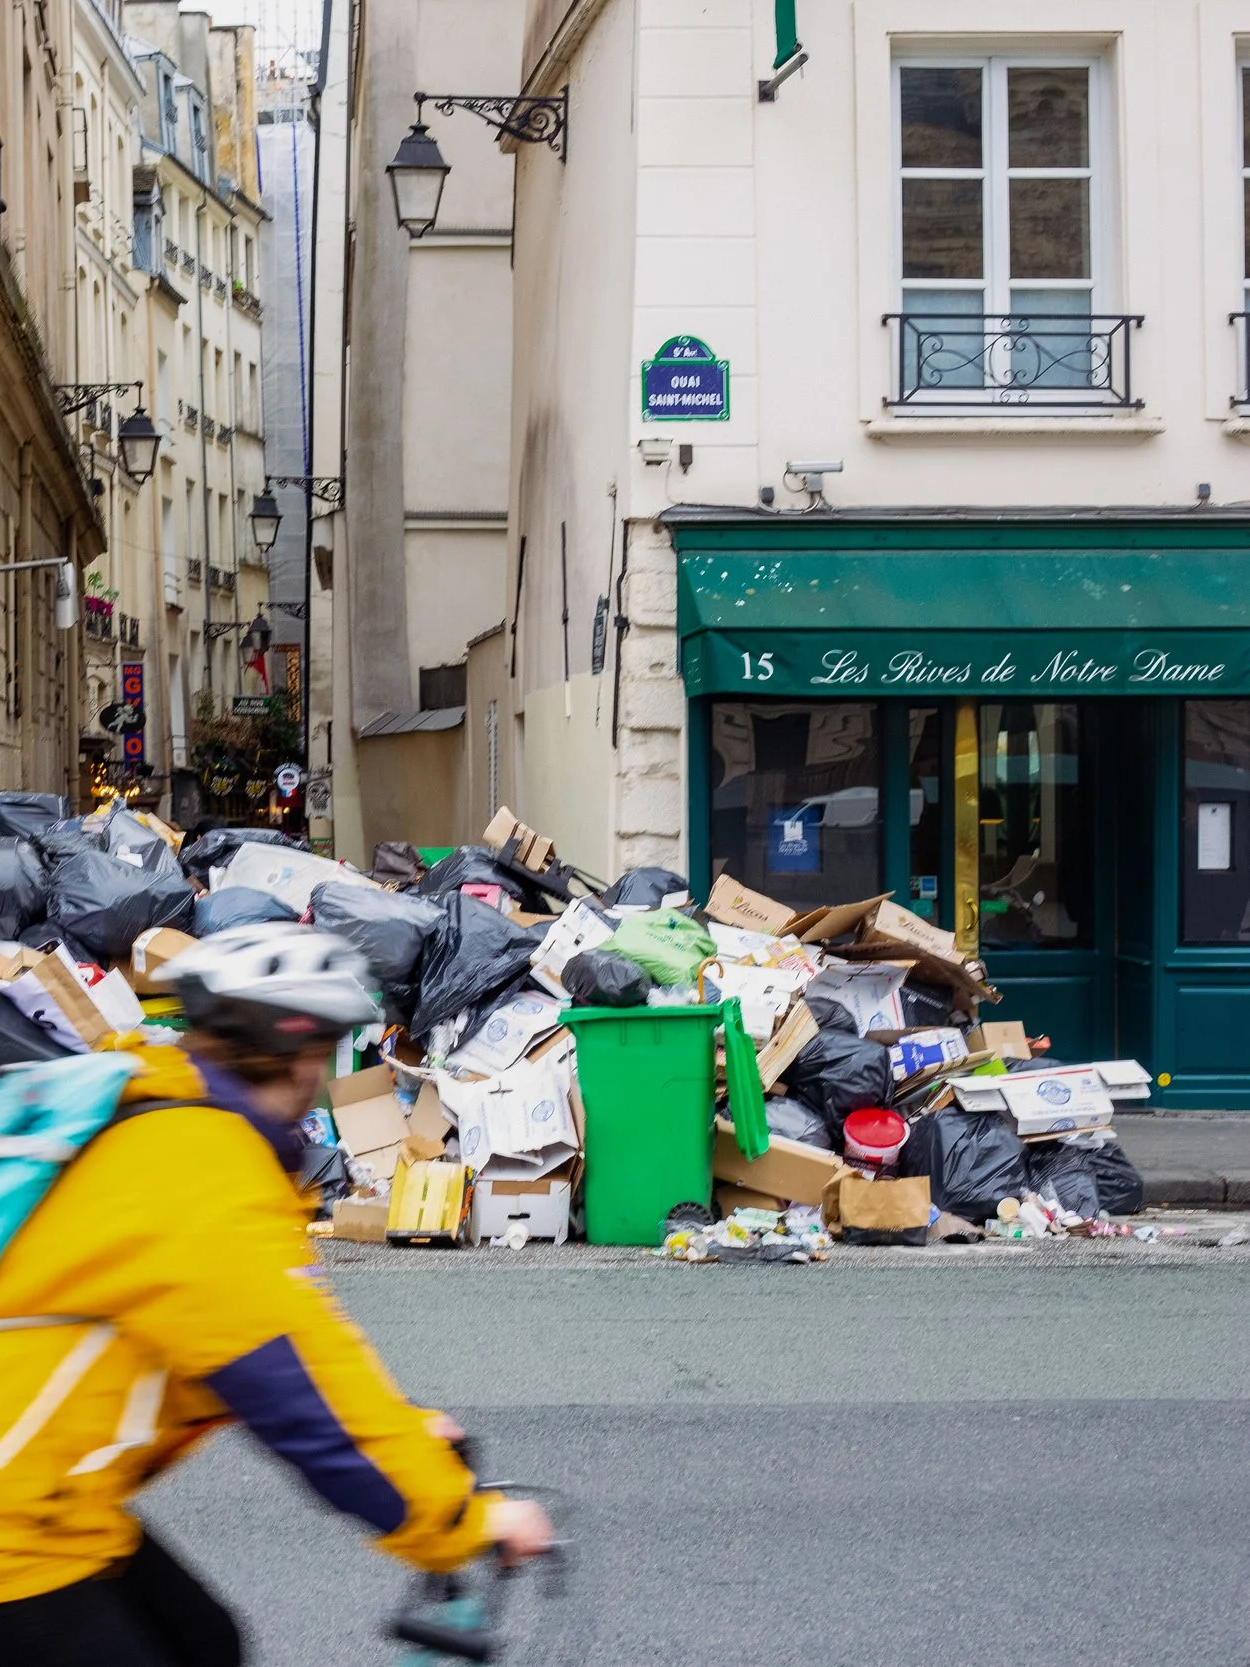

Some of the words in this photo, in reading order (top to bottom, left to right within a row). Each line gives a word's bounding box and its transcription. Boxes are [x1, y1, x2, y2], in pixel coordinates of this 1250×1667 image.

[670, 376, 701, 389] QUAI
[648, 393, 723, 406] SAINT-MICHEL
[740, 651, 775, 681] 15
[810, 649, 870, 684] Les
[881, 650, 972, 684] Rives
[981, 652, 1017, 683] de
[1030, 650, 1119, 683] Notre
[1128, 648, 1226, 682] Dame
